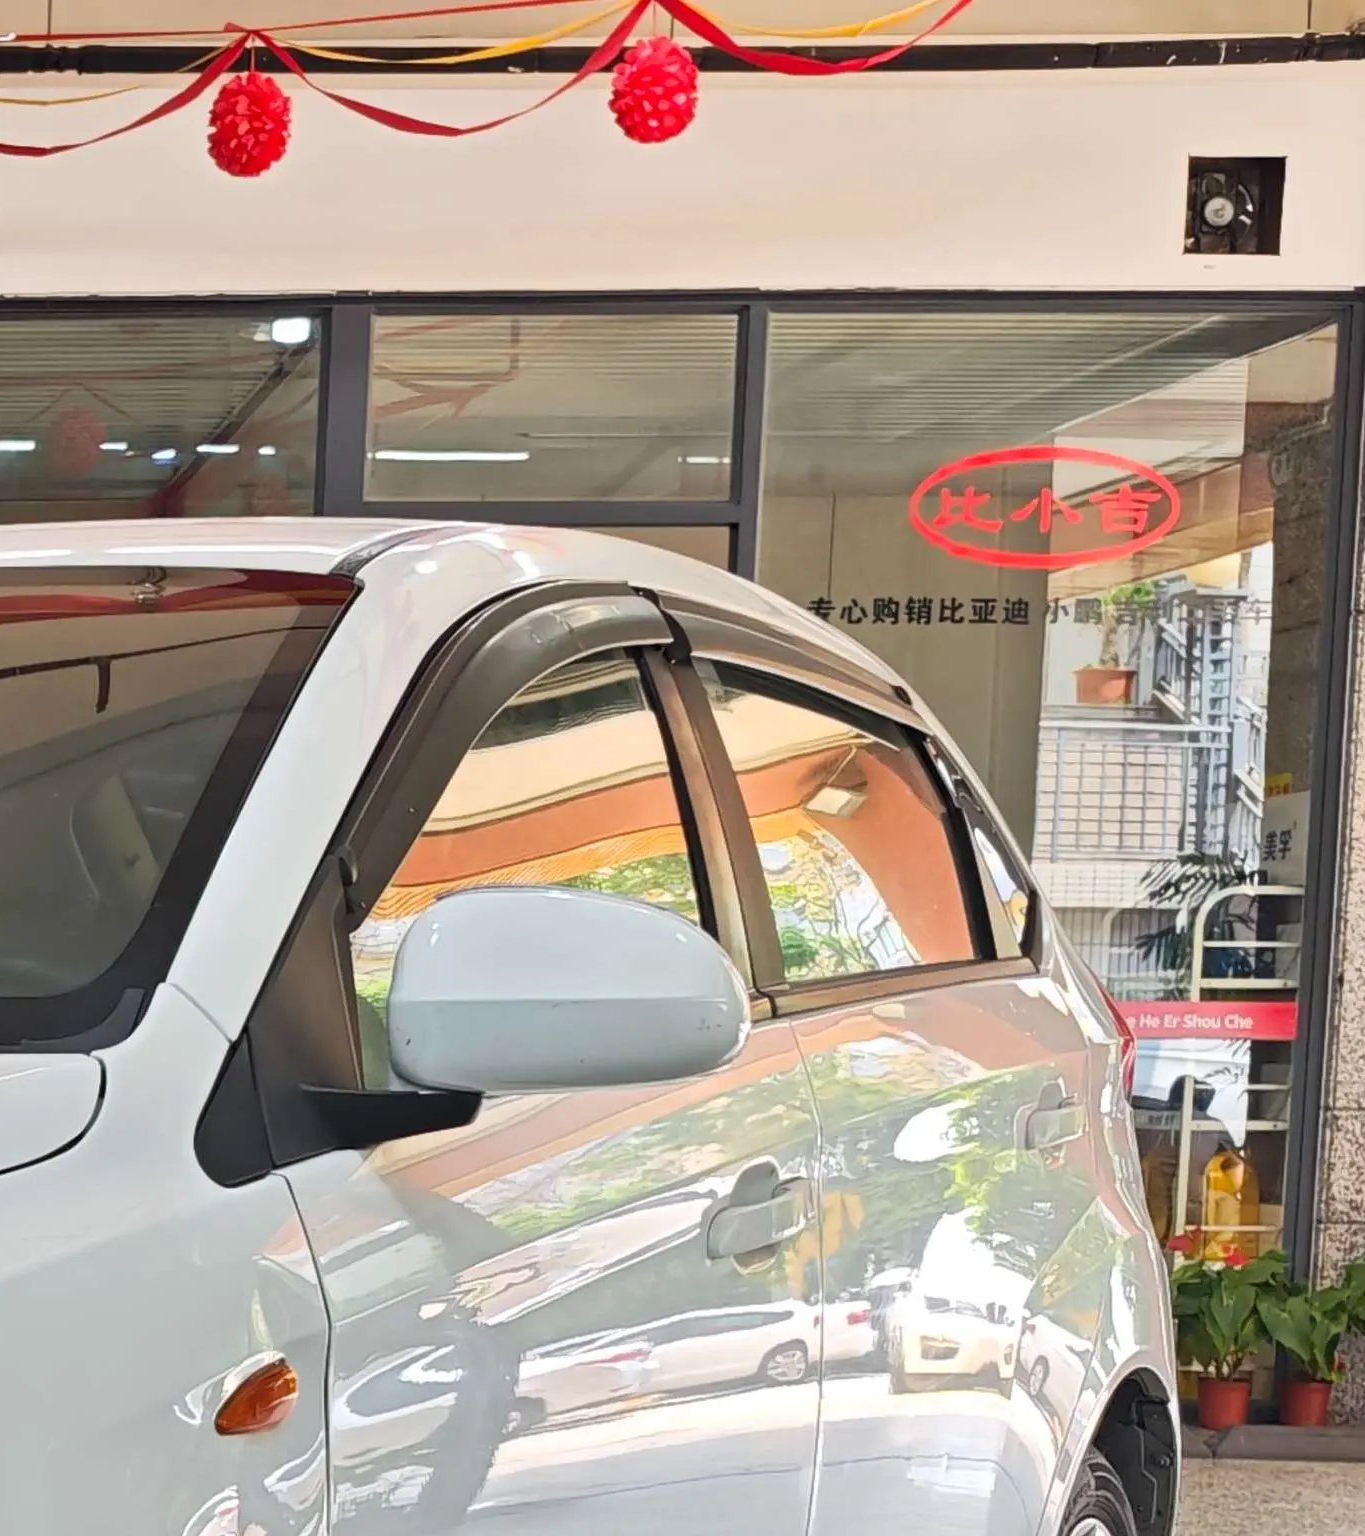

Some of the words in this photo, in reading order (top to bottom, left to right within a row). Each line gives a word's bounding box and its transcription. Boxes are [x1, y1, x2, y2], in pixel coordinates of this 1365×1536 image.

[932, 486, 1162, 533] 比小吉
[807, 597, 1030, 625] 专心购销比亚迪
[1139, 1014, 1161, 1029] He
[1164, 1014, 1182, 1029] Er
[1183, 1014, 1221, 1029] Shou
[1224, 1013, 1254, 1029] Che
